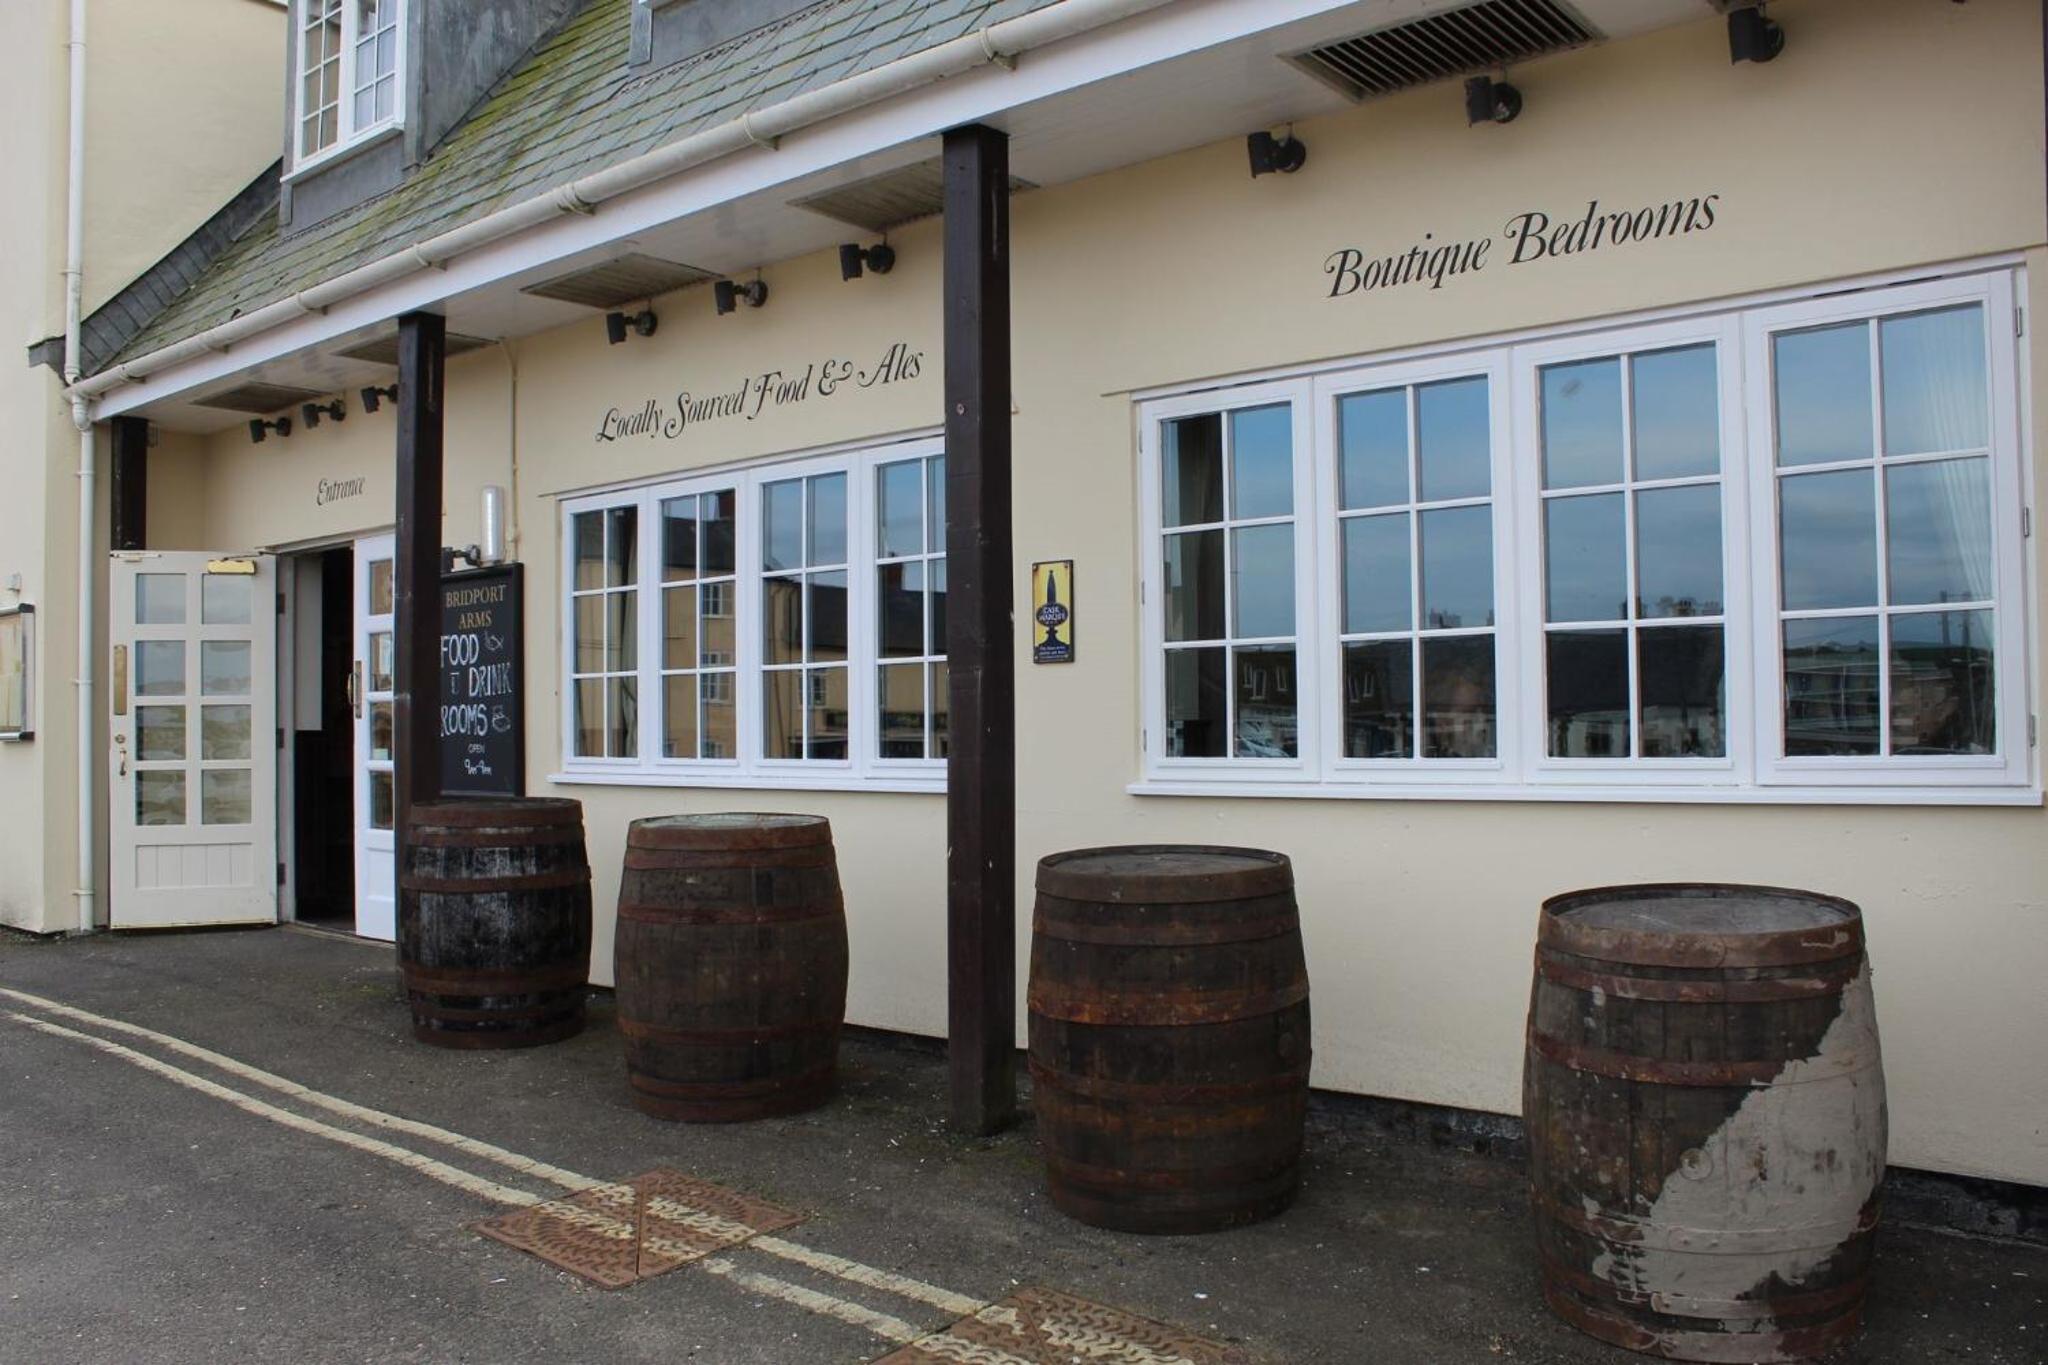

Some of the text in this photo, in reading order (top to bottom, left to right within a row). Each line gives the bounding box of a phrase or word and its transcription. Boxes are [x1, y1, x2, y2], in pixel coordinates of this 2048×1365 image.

[1324, 193, 1720, 298] Boutique Bedrooms
[596, 343, 924, 442] Locally Sourced Food & Ales
[317, 477, 366, 506] Entrance
[446, 584, 506, 608] BRIDPORT
[458, 610, 493, 630] ARMS
[440, 634, 479, 668] FOOD
[469, 662, 512, 697] DRINK
[440, 703, 488, 737] ROOMS
